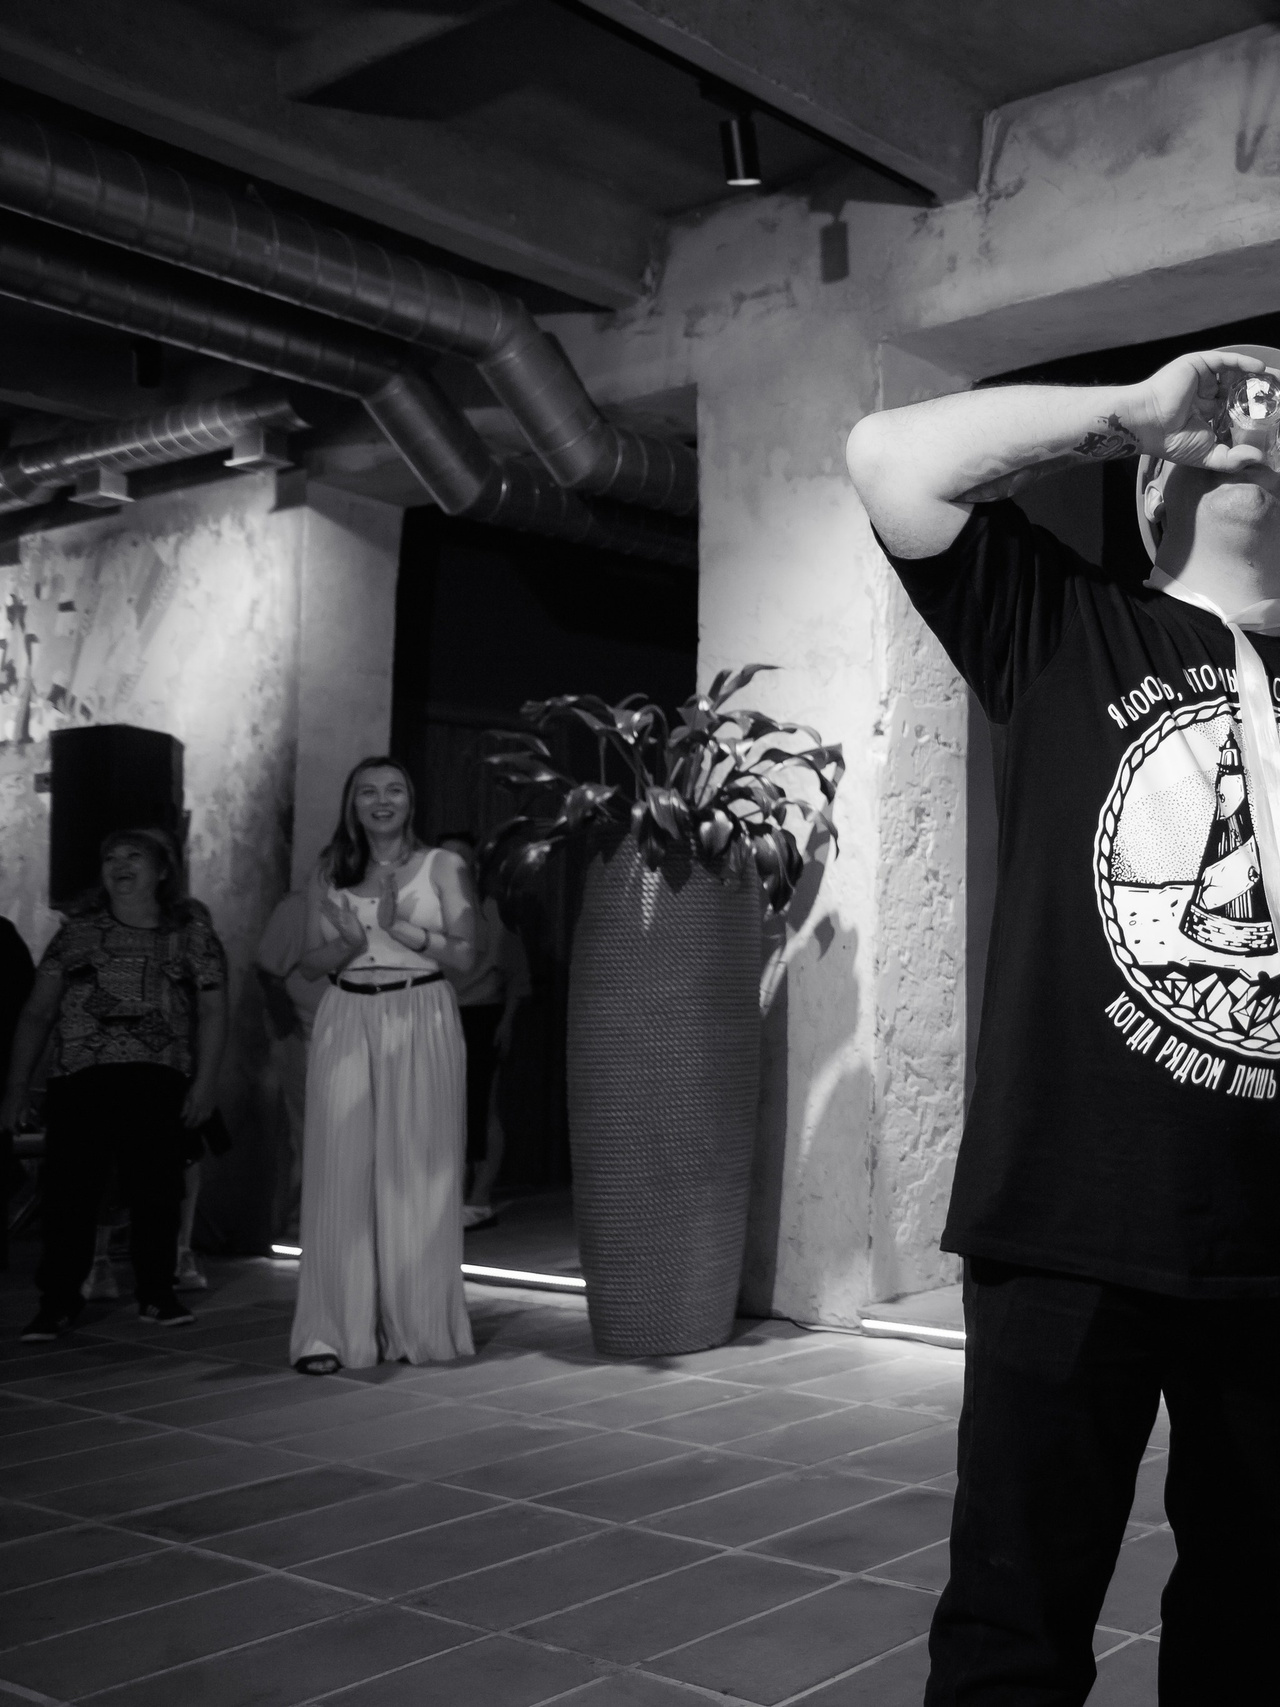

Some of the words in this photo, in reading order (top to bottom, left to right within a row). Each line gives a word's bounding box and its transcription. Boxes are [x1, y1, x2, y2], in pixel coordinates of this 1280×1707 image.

[1107, 703, 1128, 729] Я
[1120, 675, 1183, 722] БОЮЬ,
[1104, 991, 1162, 1055] КОГДА
[1154, 1035, 1226, 1090] РЯДОМ
[1226, 1064, 1278, 1100] ЛИШЬ
